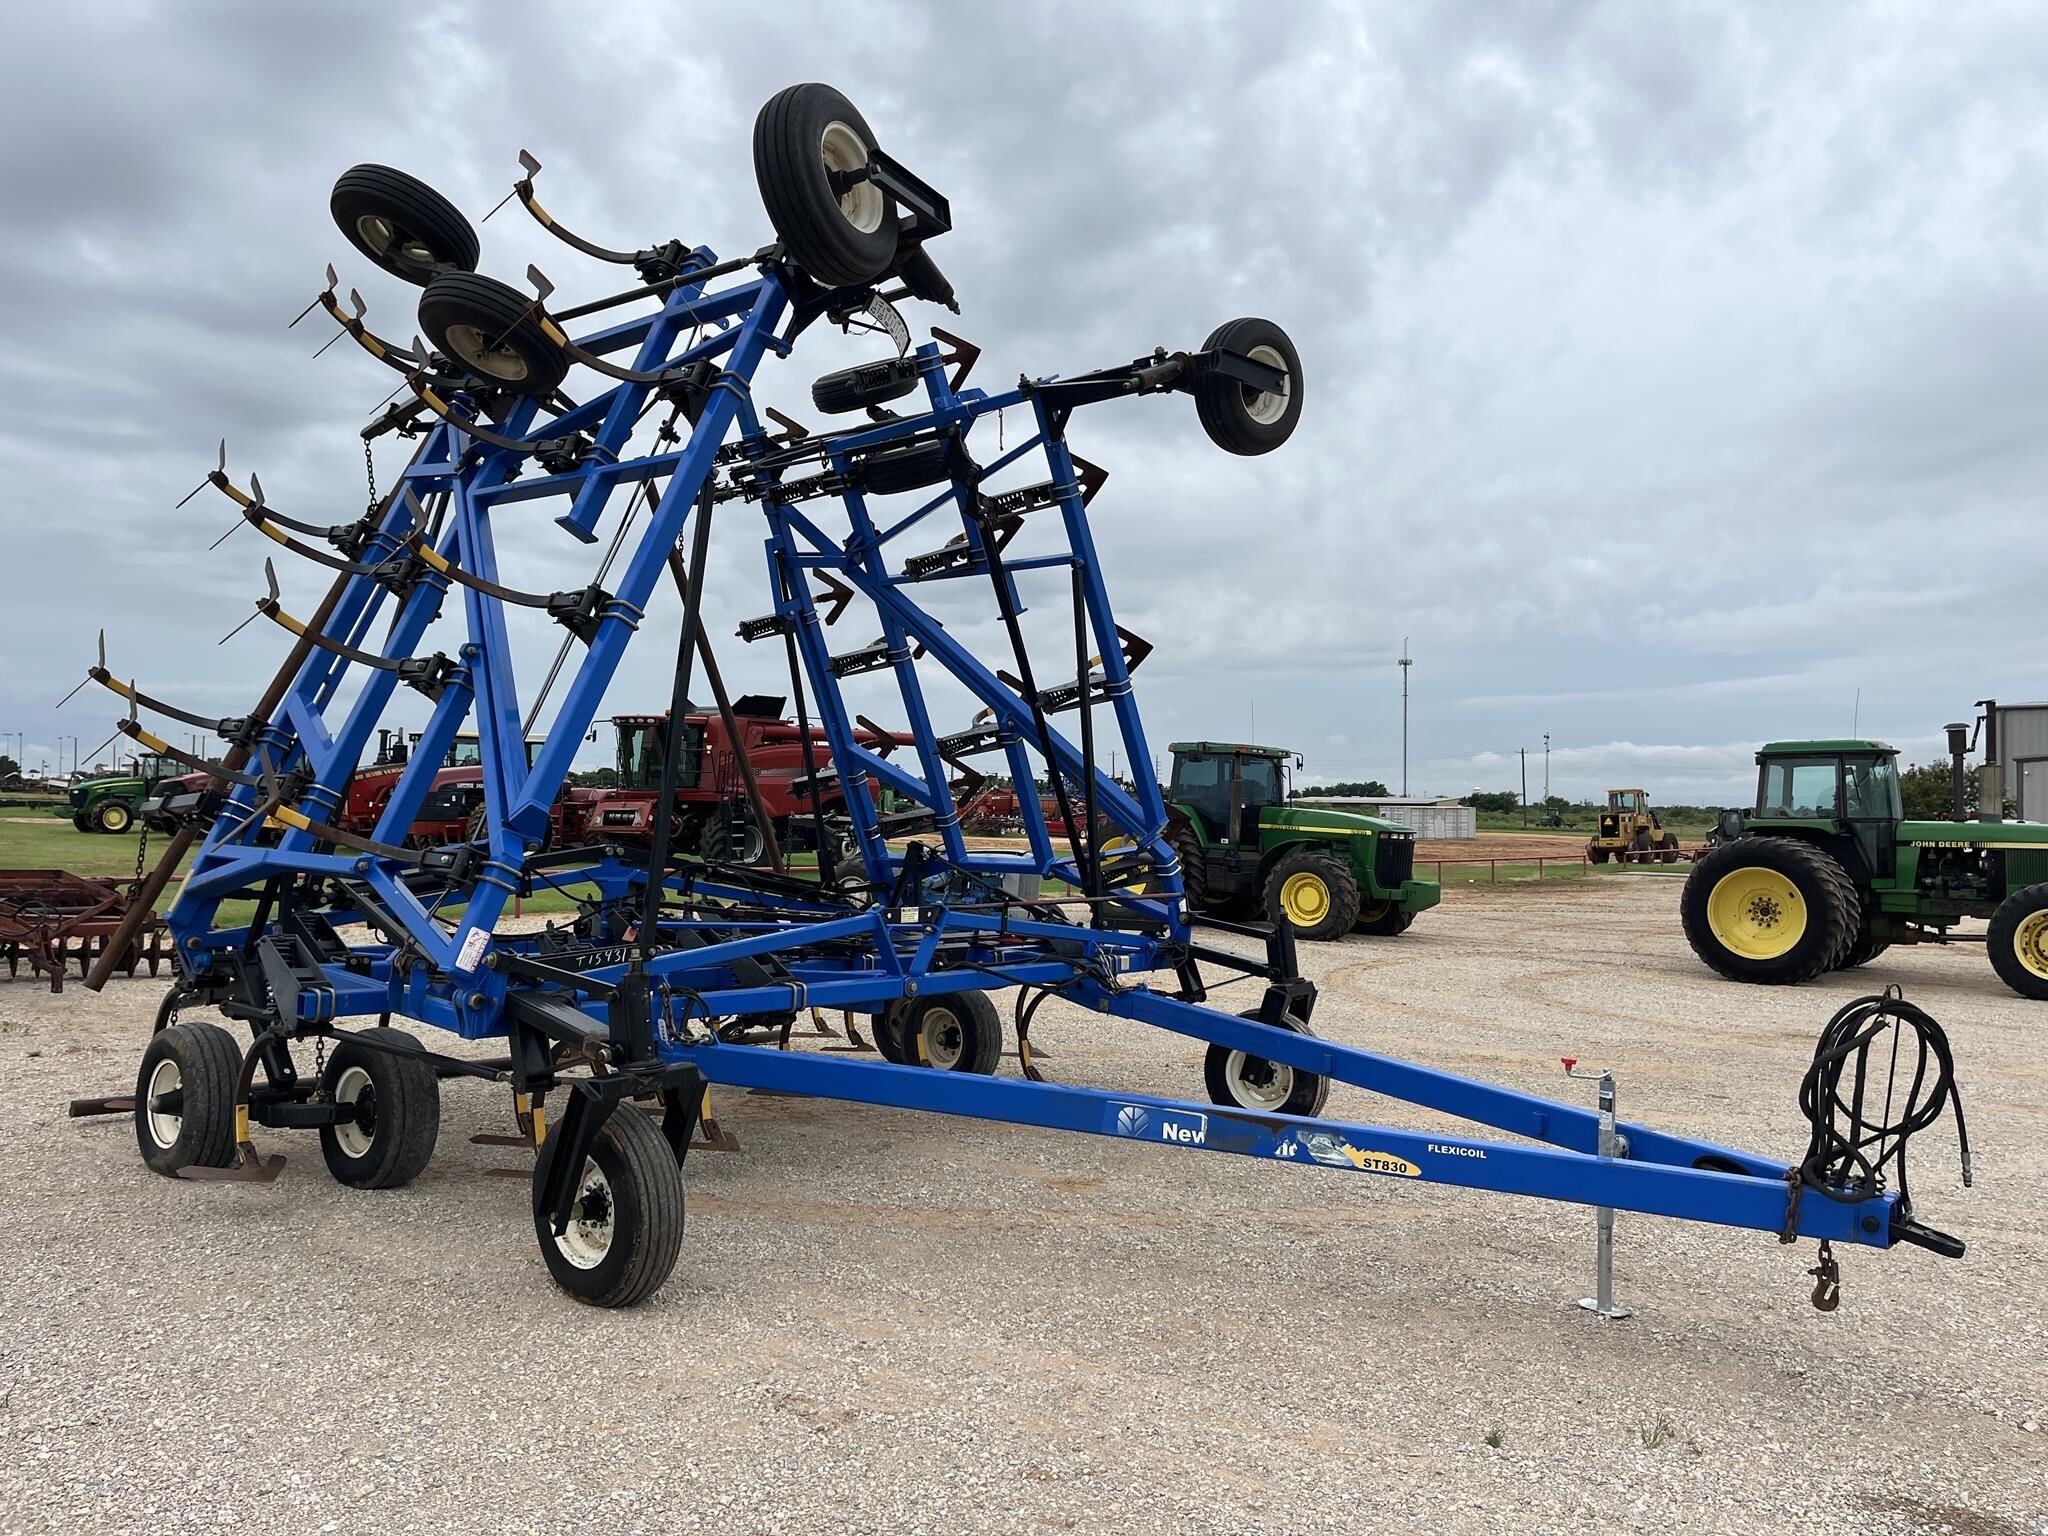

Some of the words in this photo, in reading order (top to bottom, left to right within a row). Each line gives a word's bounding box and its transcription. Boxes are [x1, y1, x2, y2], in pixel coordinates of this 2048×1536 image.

[383, 767, 405, 775] VERSA
[576, 948, 627, 967] T15431
[1162, 1122, 1205, 1144] New
[1427, 1143, 1487, 1159] FLEXICOIL
[1363, 1158, 1407, 1174] ST830
